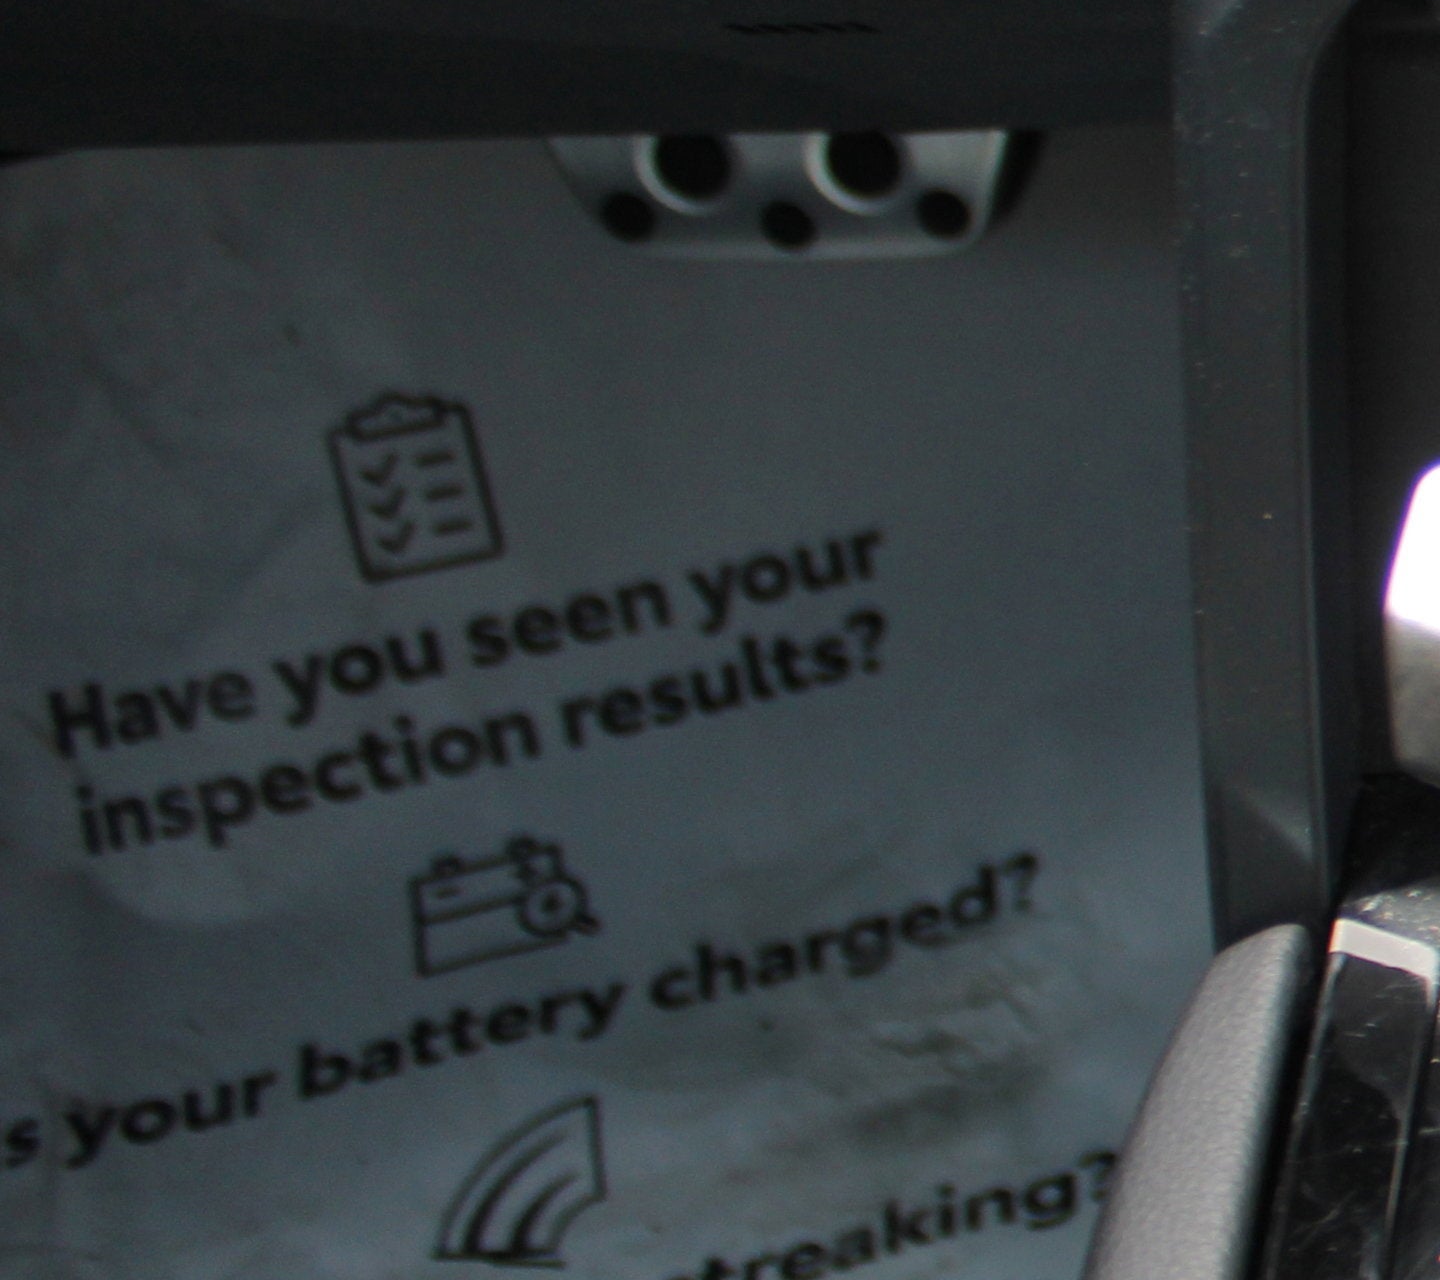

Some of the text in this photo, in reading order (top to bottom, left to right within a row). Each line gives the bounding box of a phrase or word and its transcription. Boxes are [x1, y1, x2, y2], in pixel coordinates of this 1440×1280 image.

[47, 528, 884, 759] Have you seen your
[73, 611, 887, 856] inspection results?
[0, 854, 1041, 1171] s your battery charged?
